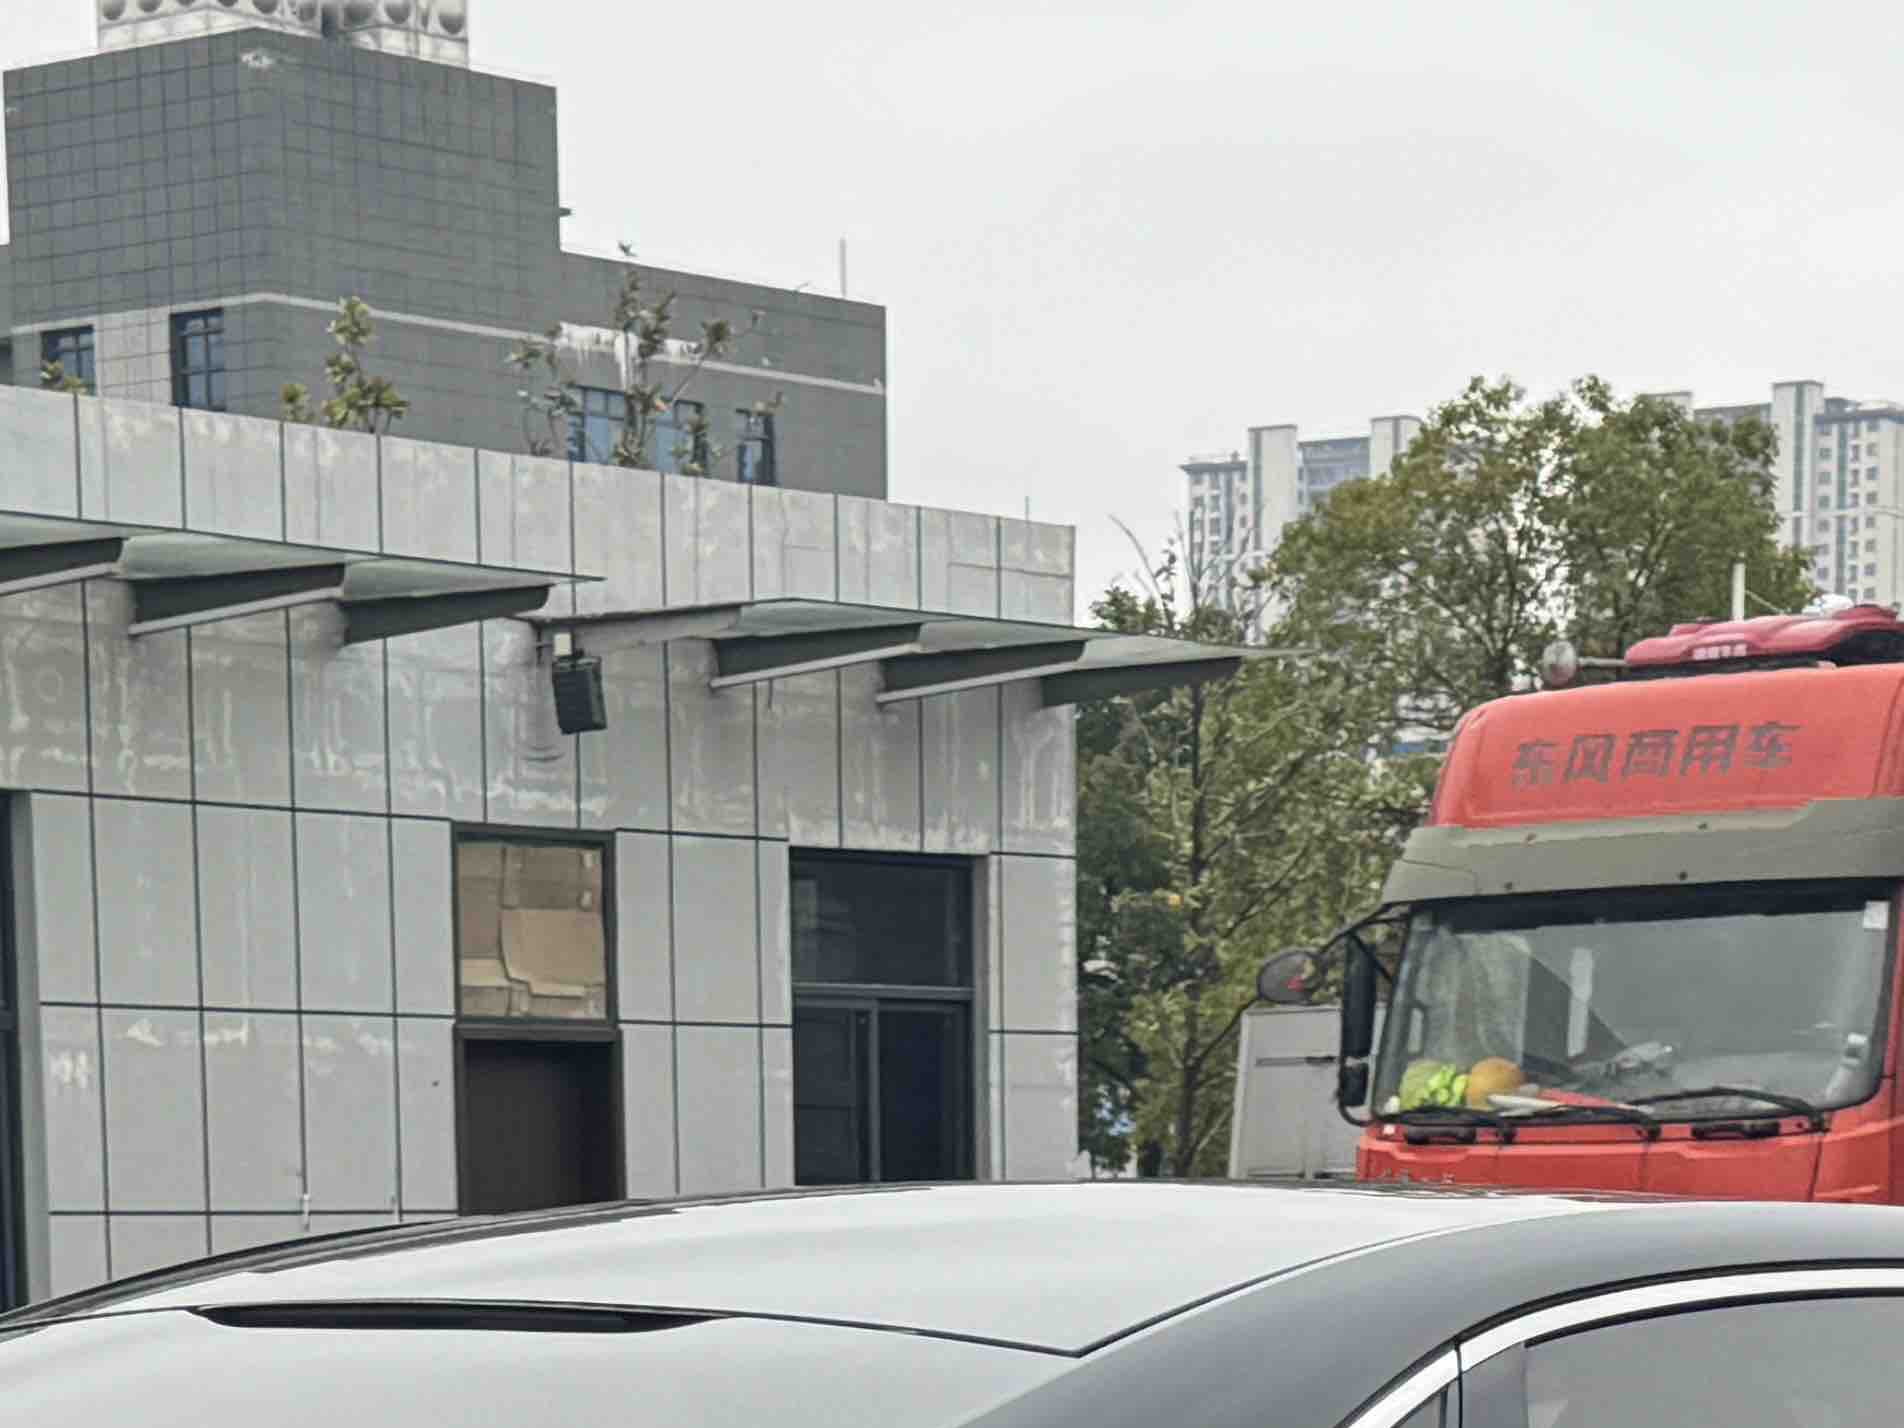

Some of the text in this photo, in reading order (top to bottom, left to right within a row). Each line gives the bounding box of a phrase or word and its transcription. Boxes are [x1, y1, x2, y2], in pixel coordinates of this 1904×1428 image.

[1510, 721, 1802, 792] 东风商用车
